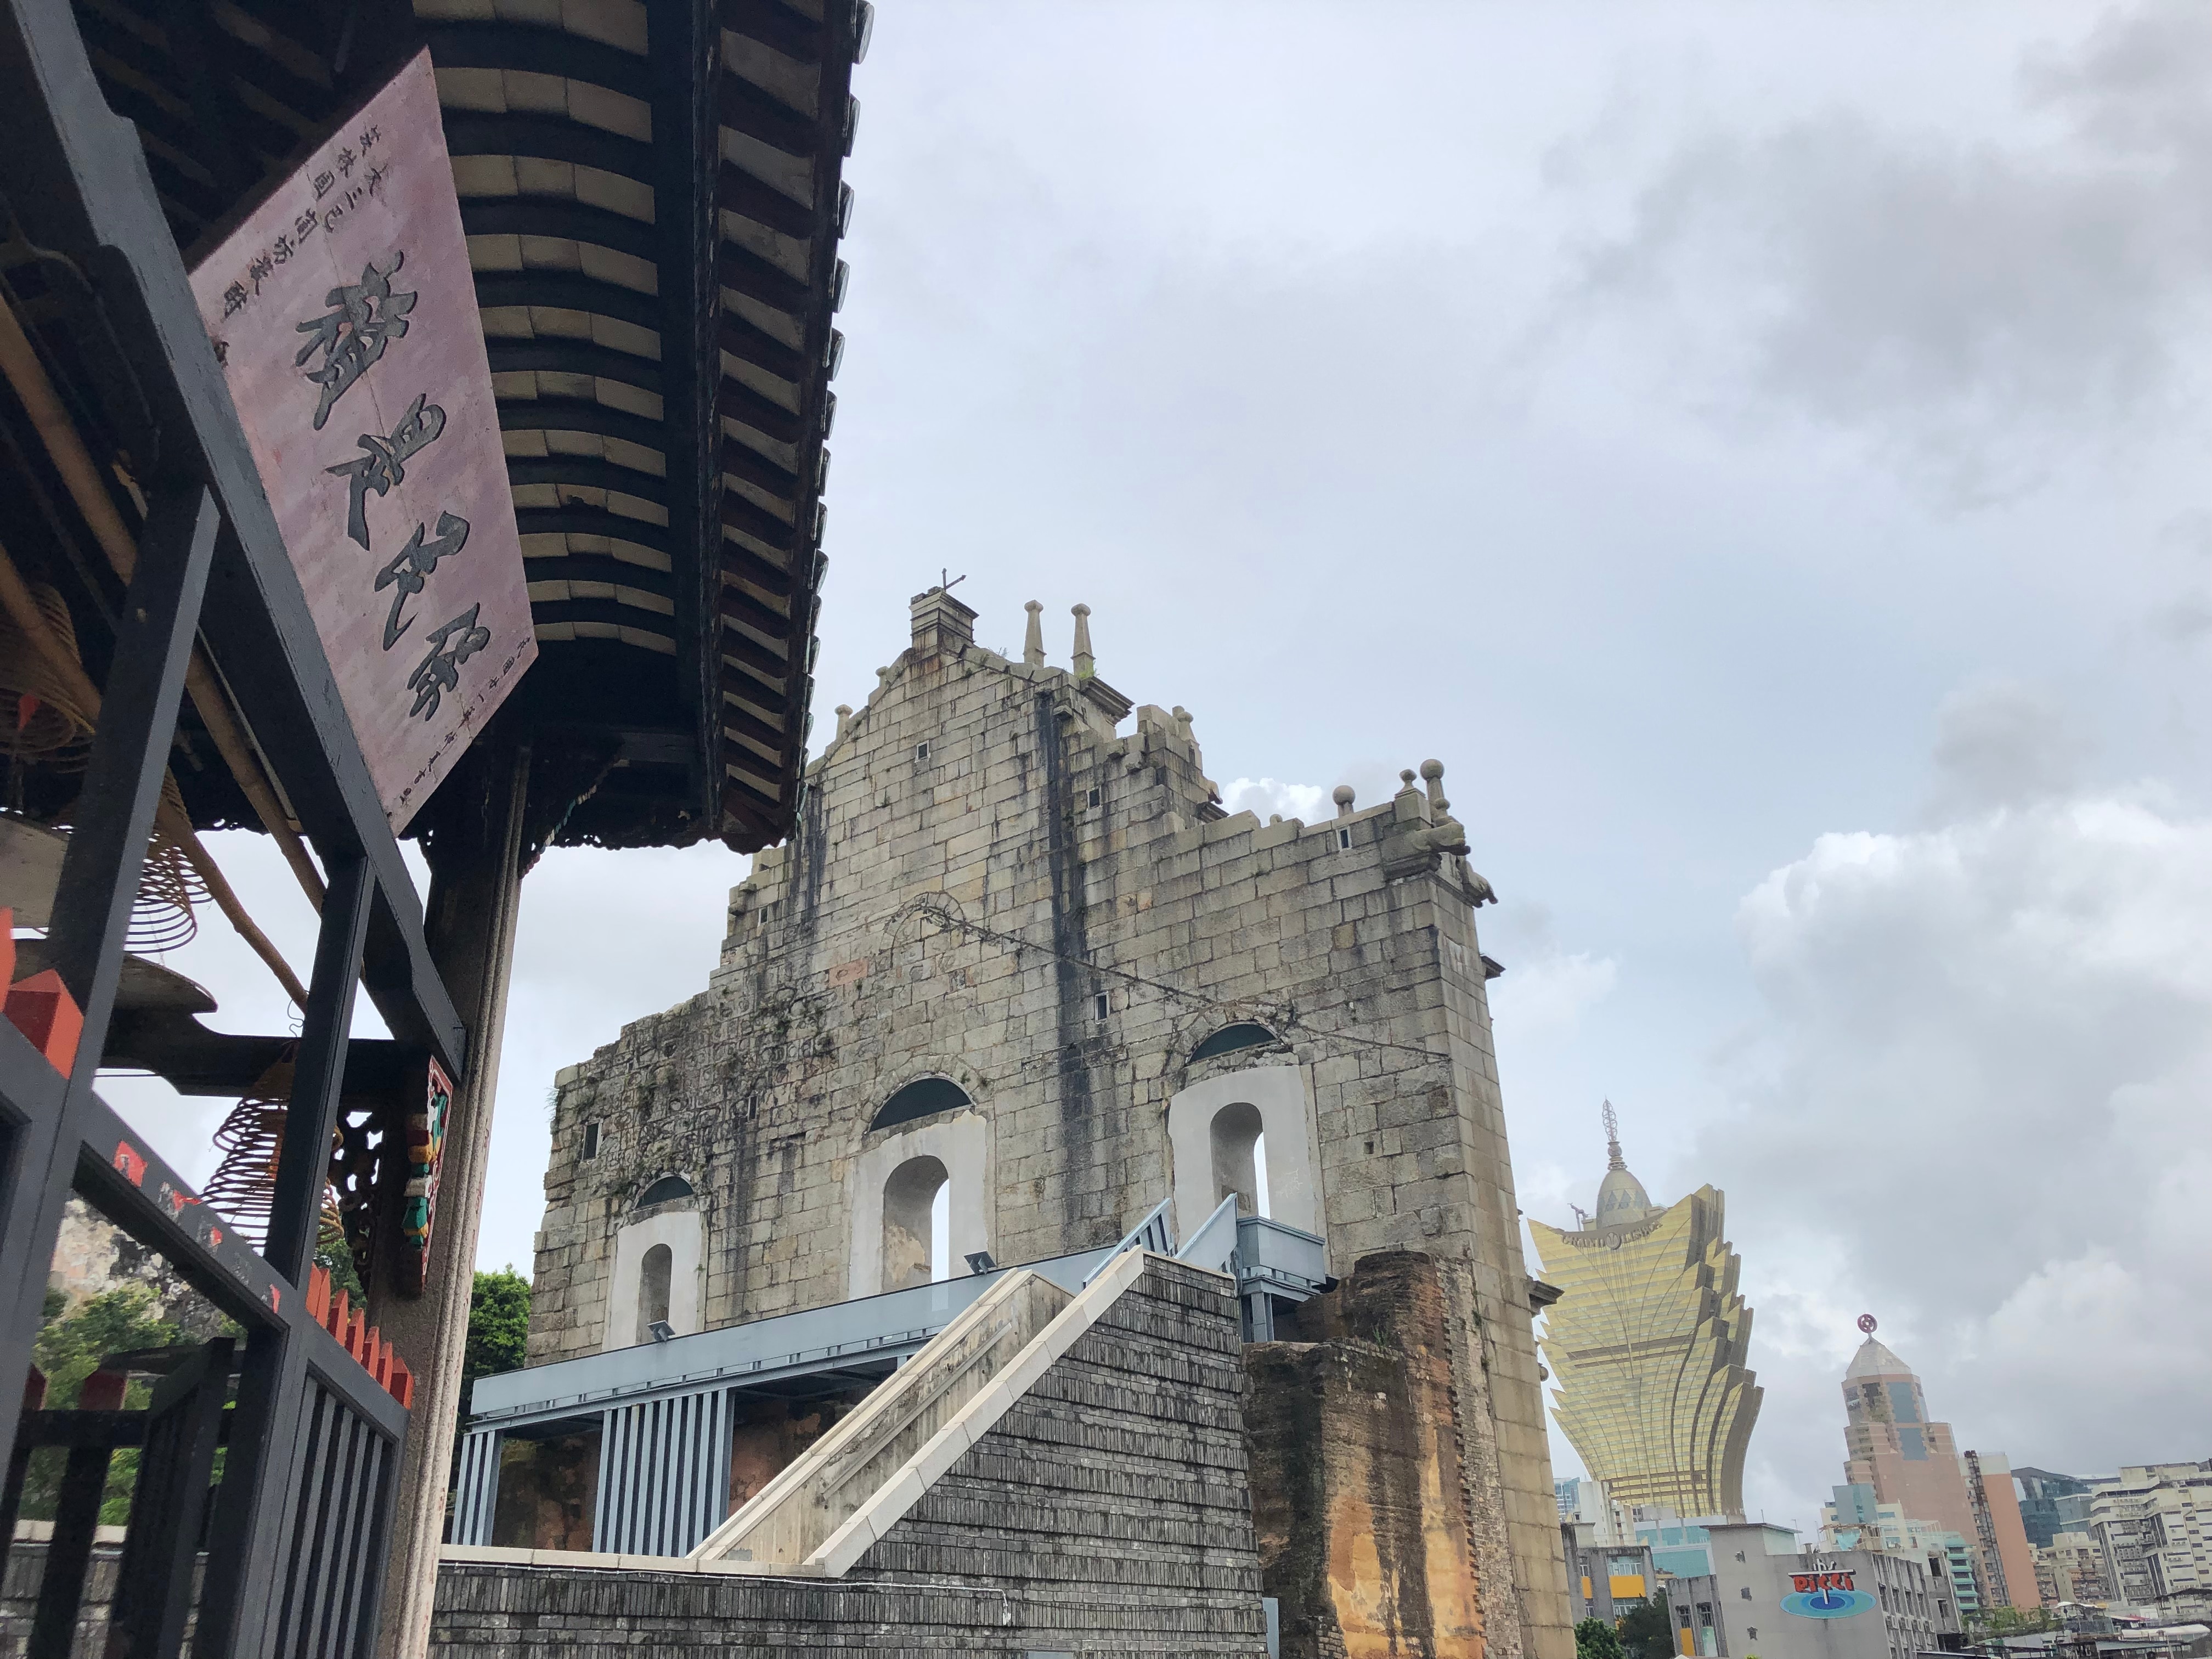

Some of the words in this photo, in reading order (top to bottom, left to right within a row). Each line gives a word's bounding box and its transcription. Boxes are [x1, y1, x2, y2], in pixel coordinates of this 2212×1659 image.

[295, 250, 492, 722] 保民是賴
[1562, 1235, 1606, 1248] GRAND
[1621, 1219, 1663, 1243] LISBOA
